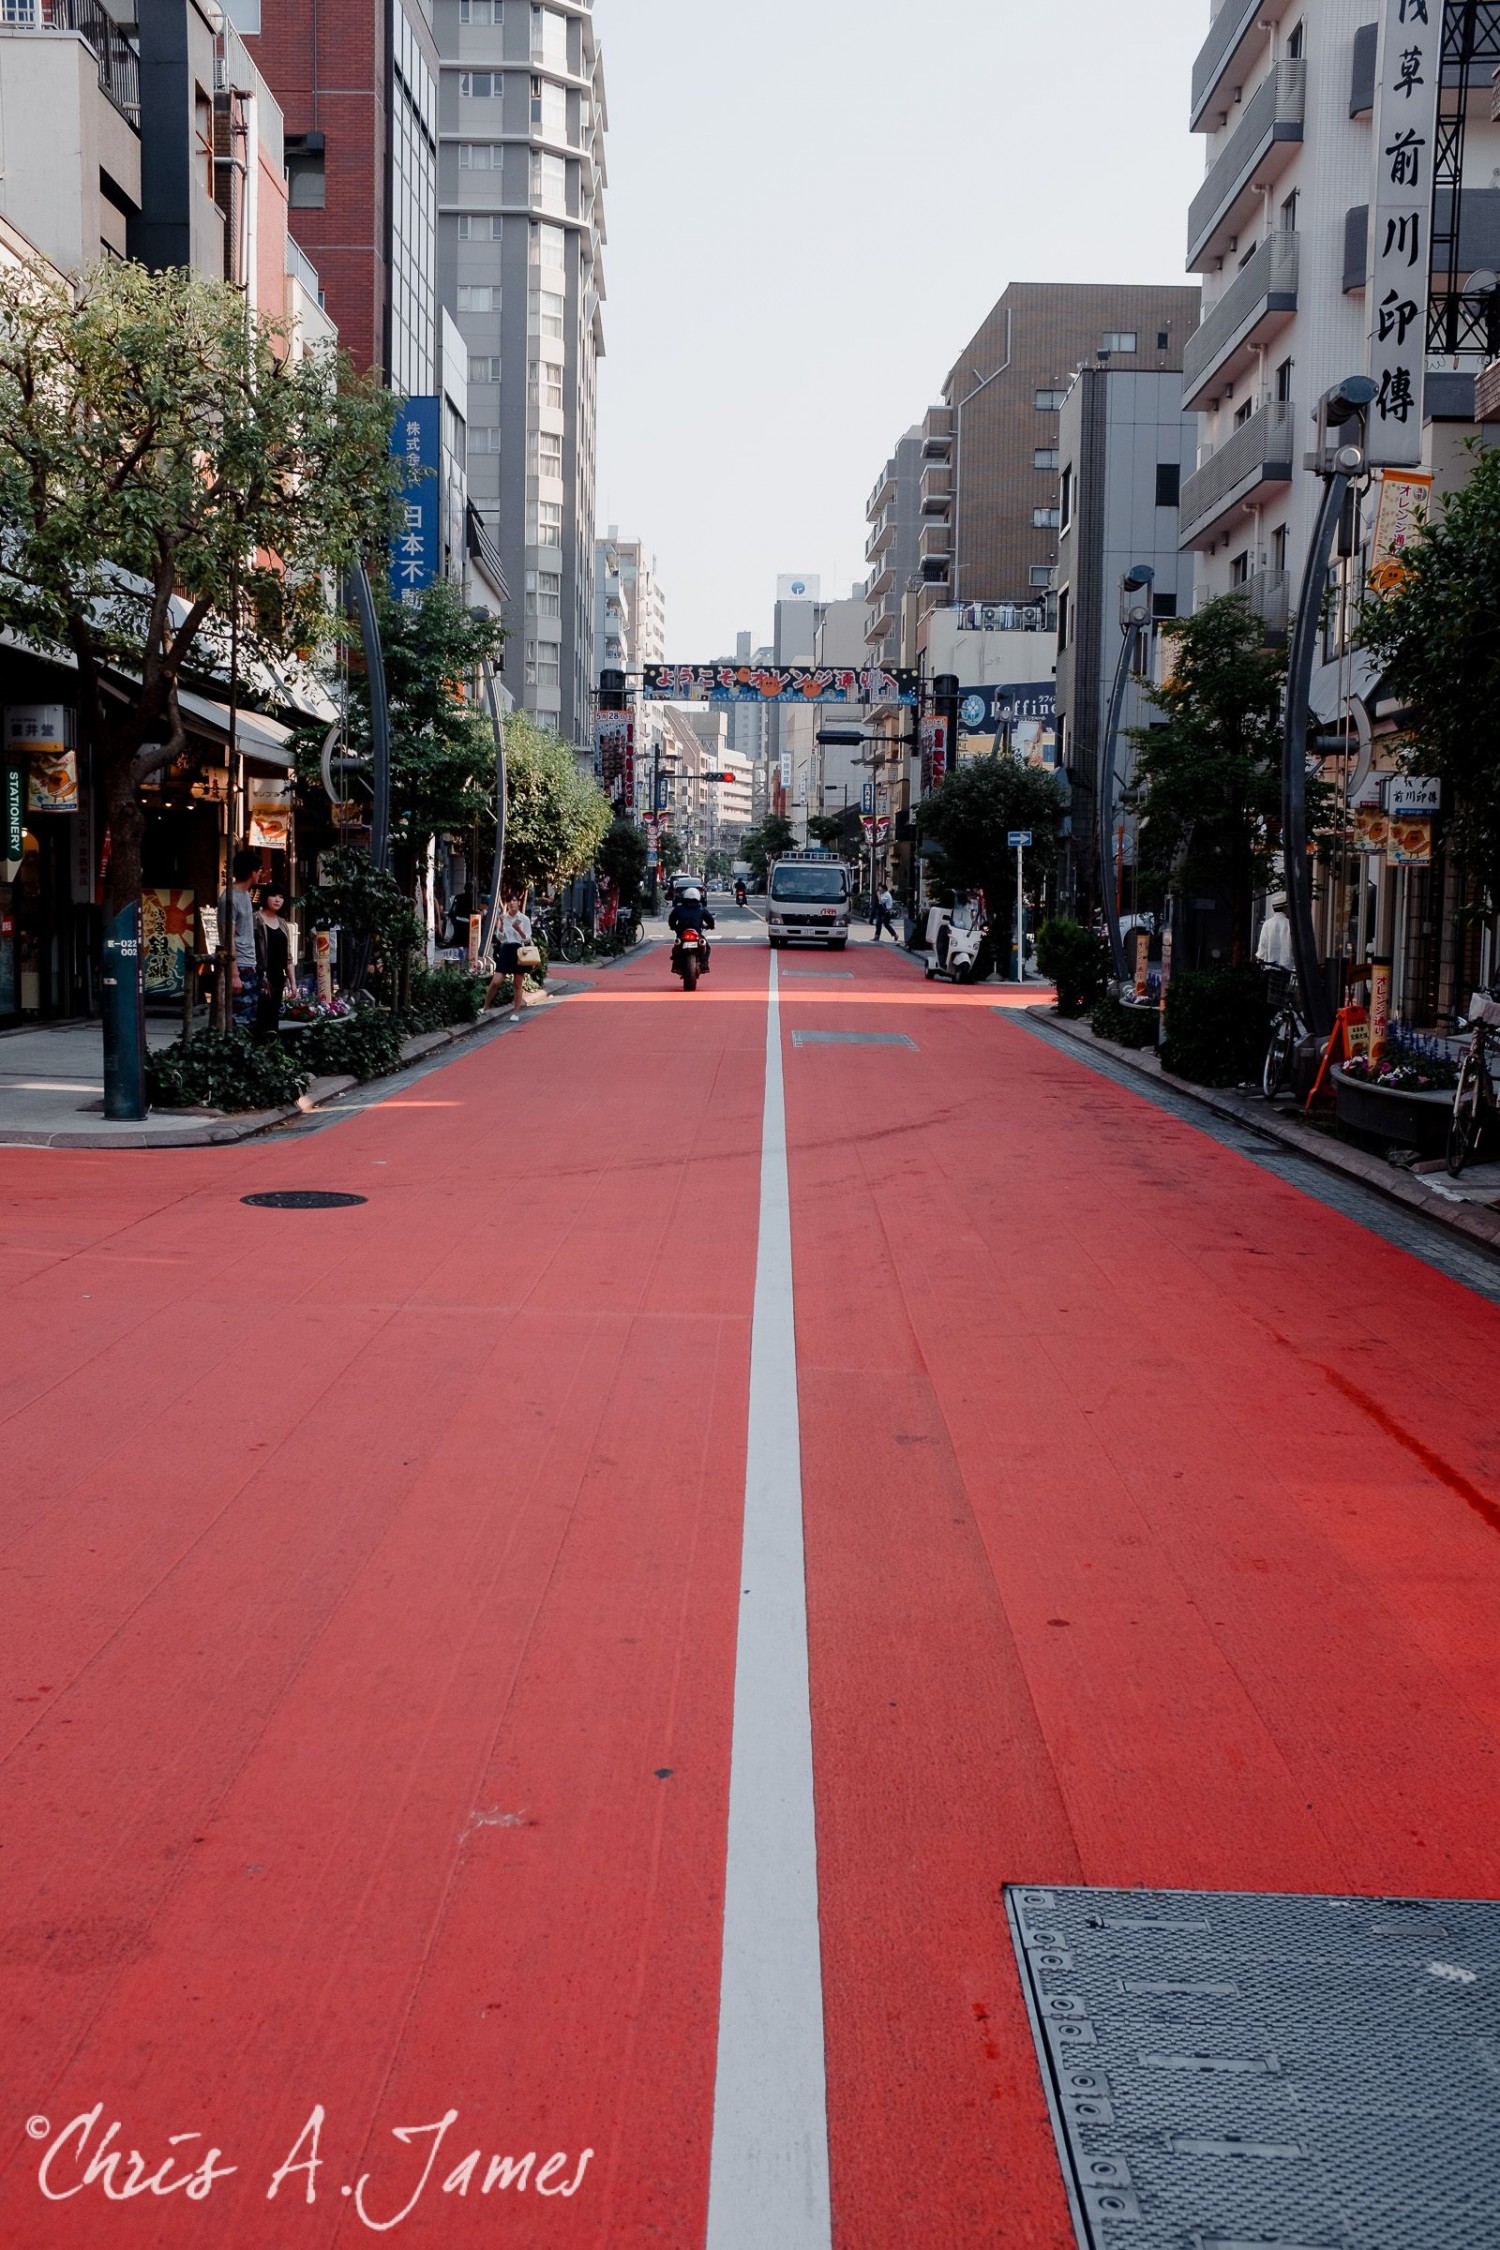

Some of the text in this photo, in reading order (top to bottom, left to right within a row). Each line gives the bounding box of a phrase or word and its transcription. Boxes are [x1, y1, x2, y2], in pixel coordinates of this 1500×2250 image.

[656, 667, 737, 688] ようこそ
[9, 771, 20, 851] STATIONERY
[121, 948, 137, 956] 002
[1374, 976, 1388, 1037] オレンジ通り
